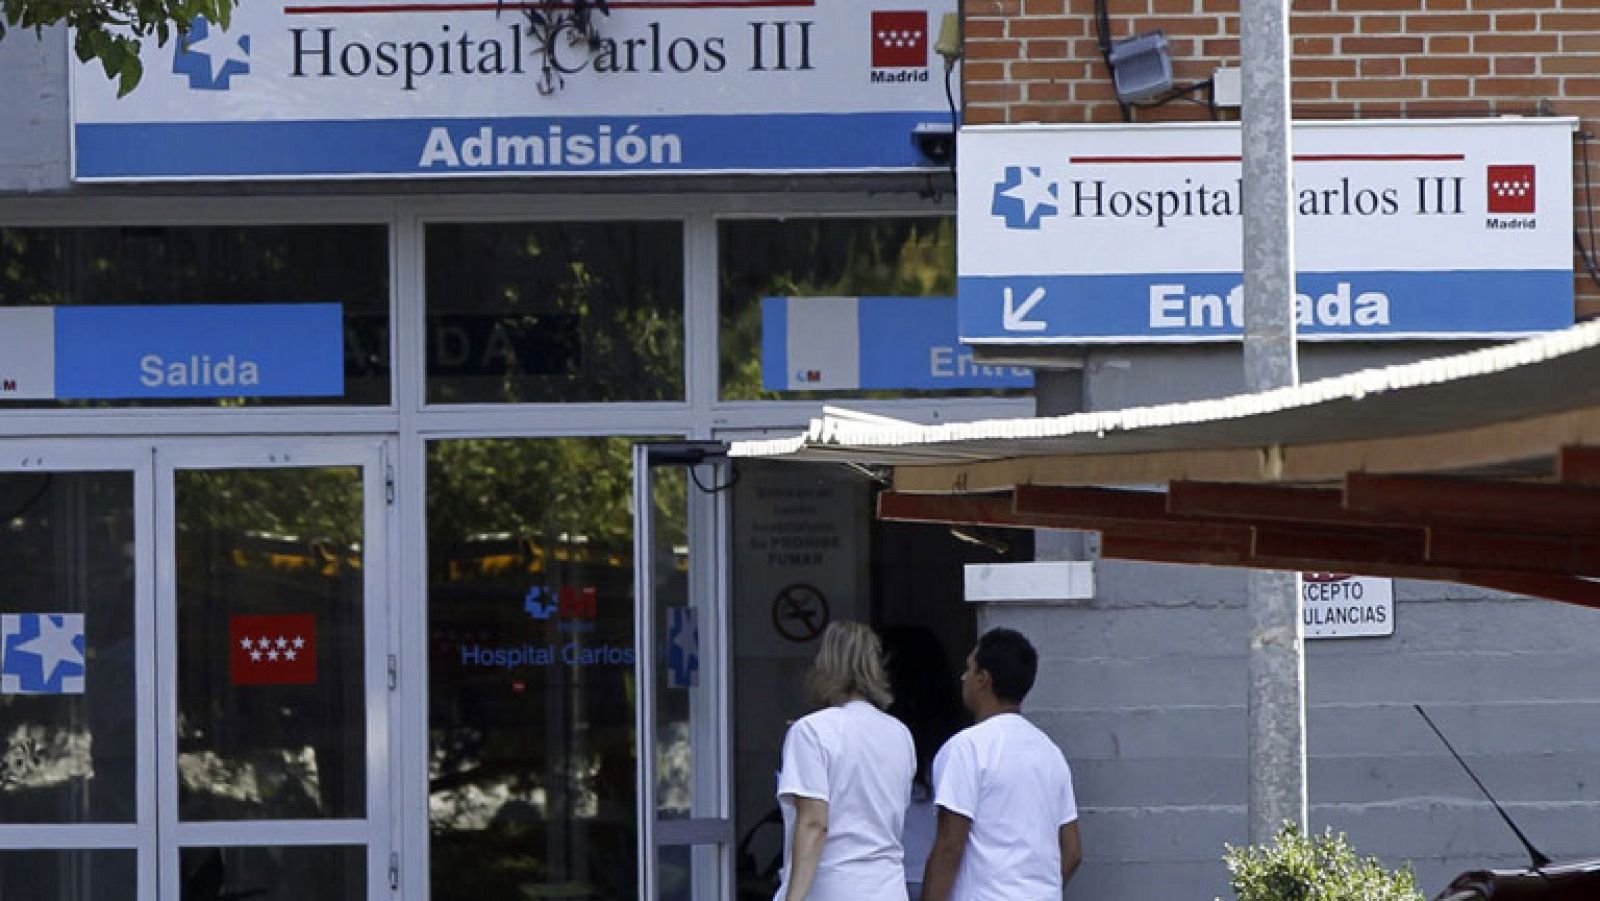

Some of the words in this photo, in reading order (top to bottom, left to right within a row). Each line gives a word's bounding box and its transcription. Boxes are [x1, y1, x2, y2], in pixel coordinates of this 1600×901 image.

[288, 23, 525, 90] Hospital
[549, 22, 726, 74] Carlos
[748, 21, 816, 72] III
[871, 69, 929, 83] Madrid
[418, 124, 682, 168] Admisión
[1072, 178, 1243, 228] Hospital
[1299, 177, 1399, 215] arlos
[1416, 176, 1466, 214] III
[1485, 218, 1537, 230] Madrid
[1149, 282, 1391, 328] Entada
[139, 353, 260, 387] Salida
[1303, 582, 1364, 601] CEPTO
[1303, 605, 1387, 625] ULANCIAS
[461, 643, 555, 670] Hospital
[561, 642, 636, 666] Carlos
